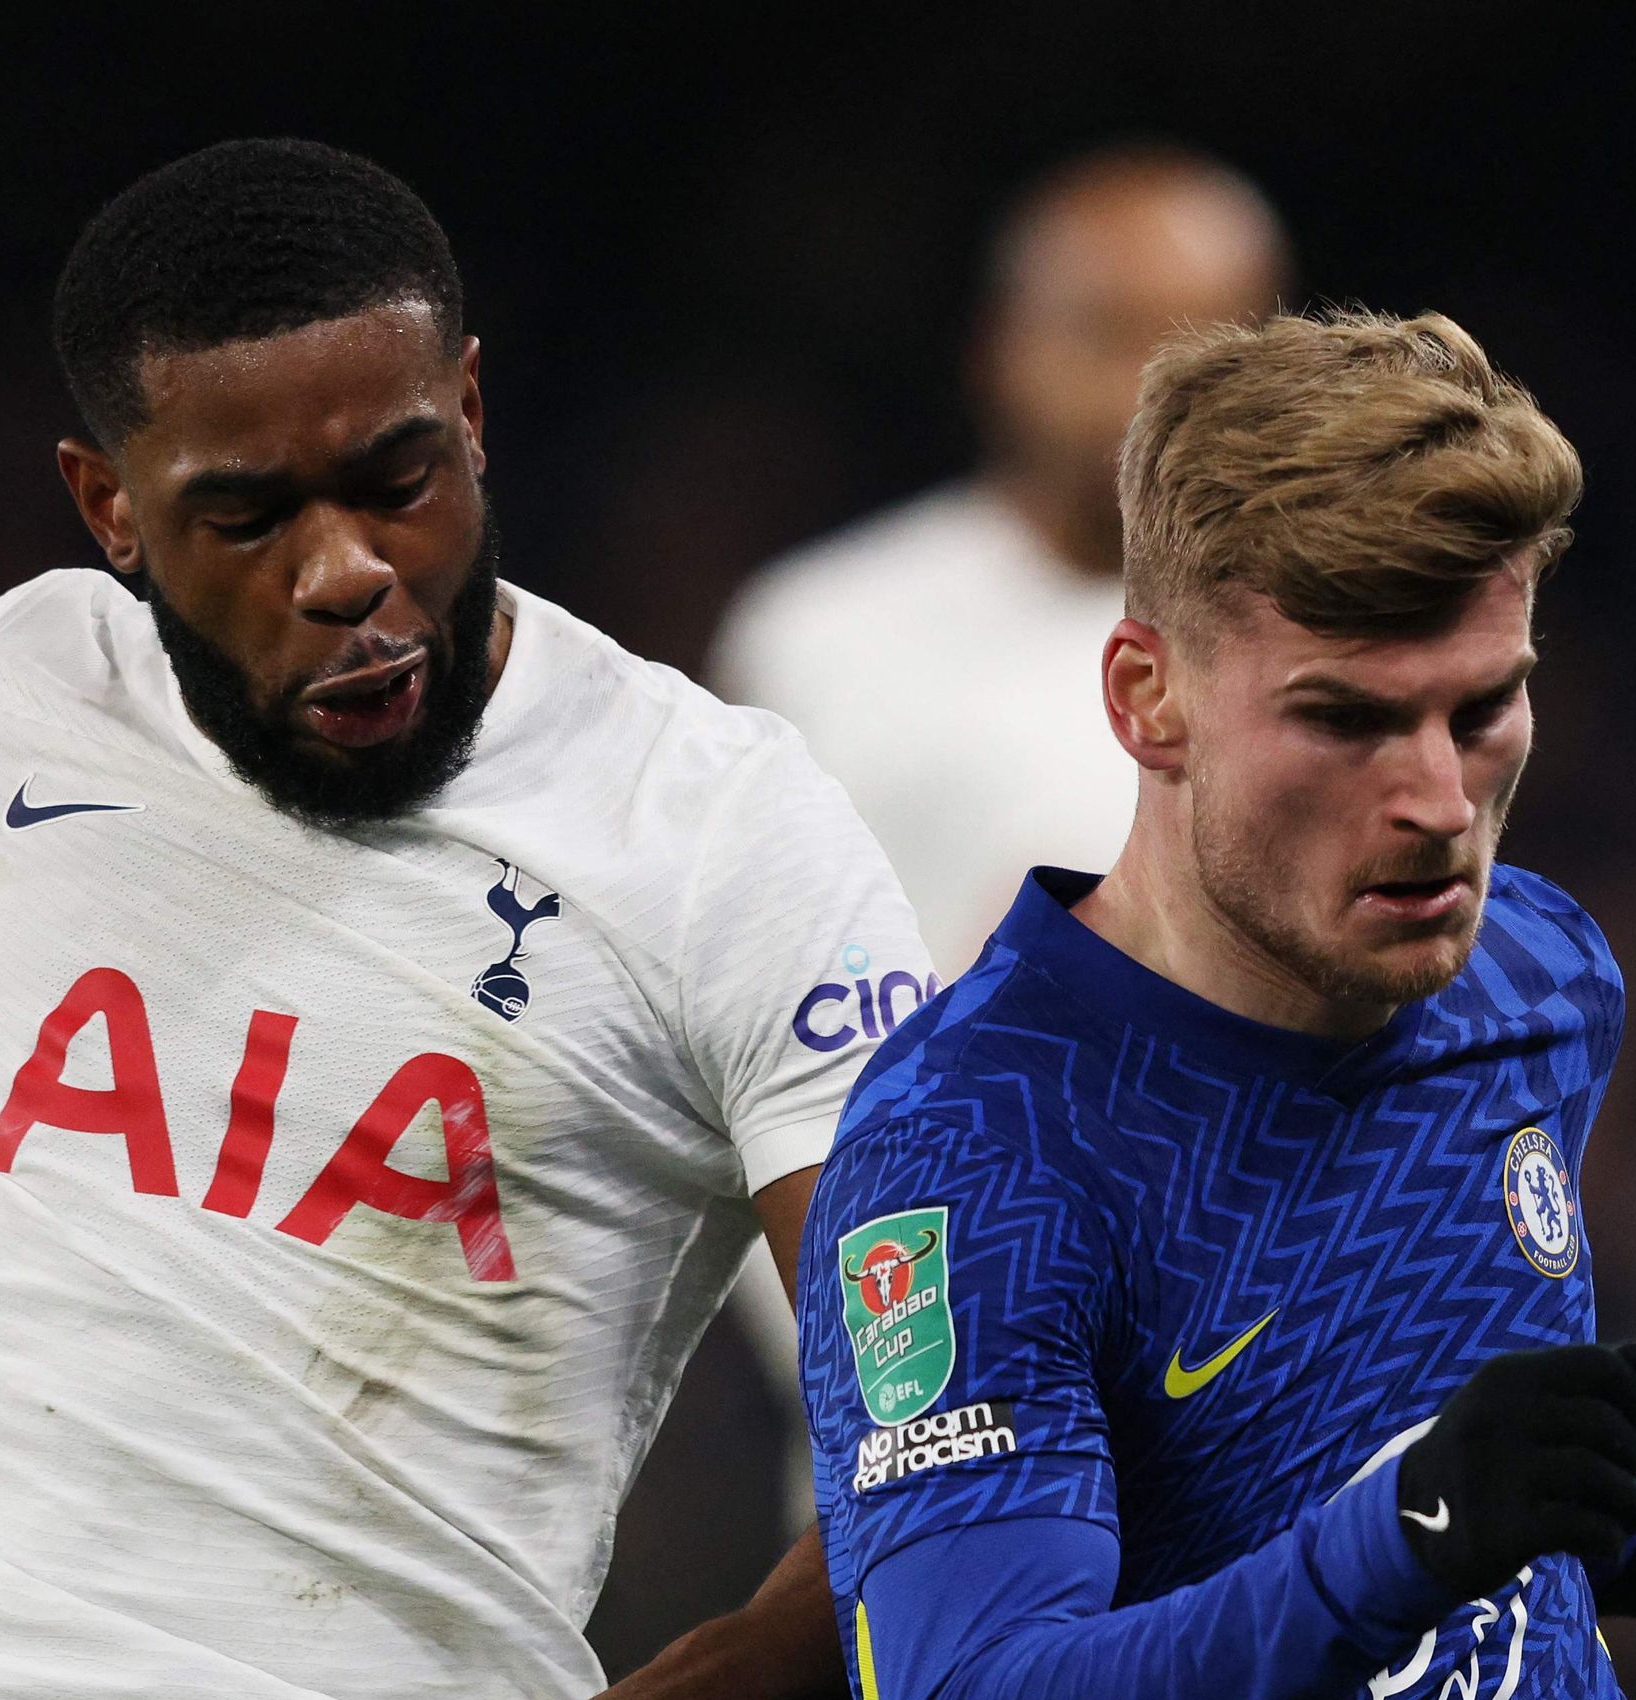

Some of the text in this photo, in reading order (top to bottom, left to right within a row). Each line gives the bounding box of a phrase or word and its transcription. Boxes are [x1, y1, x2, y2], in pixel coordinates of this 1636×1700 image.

[1510, 1133, 1552, 1172] CHELSEA
[1533, 1250, 1567, 1270] FOOTBALL
[856, 1285, 937, 1356] Carabao
[874, 1327, 913, 1368] Cup
[896, 1379, 924, 1401] EFL
[858, 1402, 994, 1470] No room
[853, 1426, 1017, 1495] for racism
